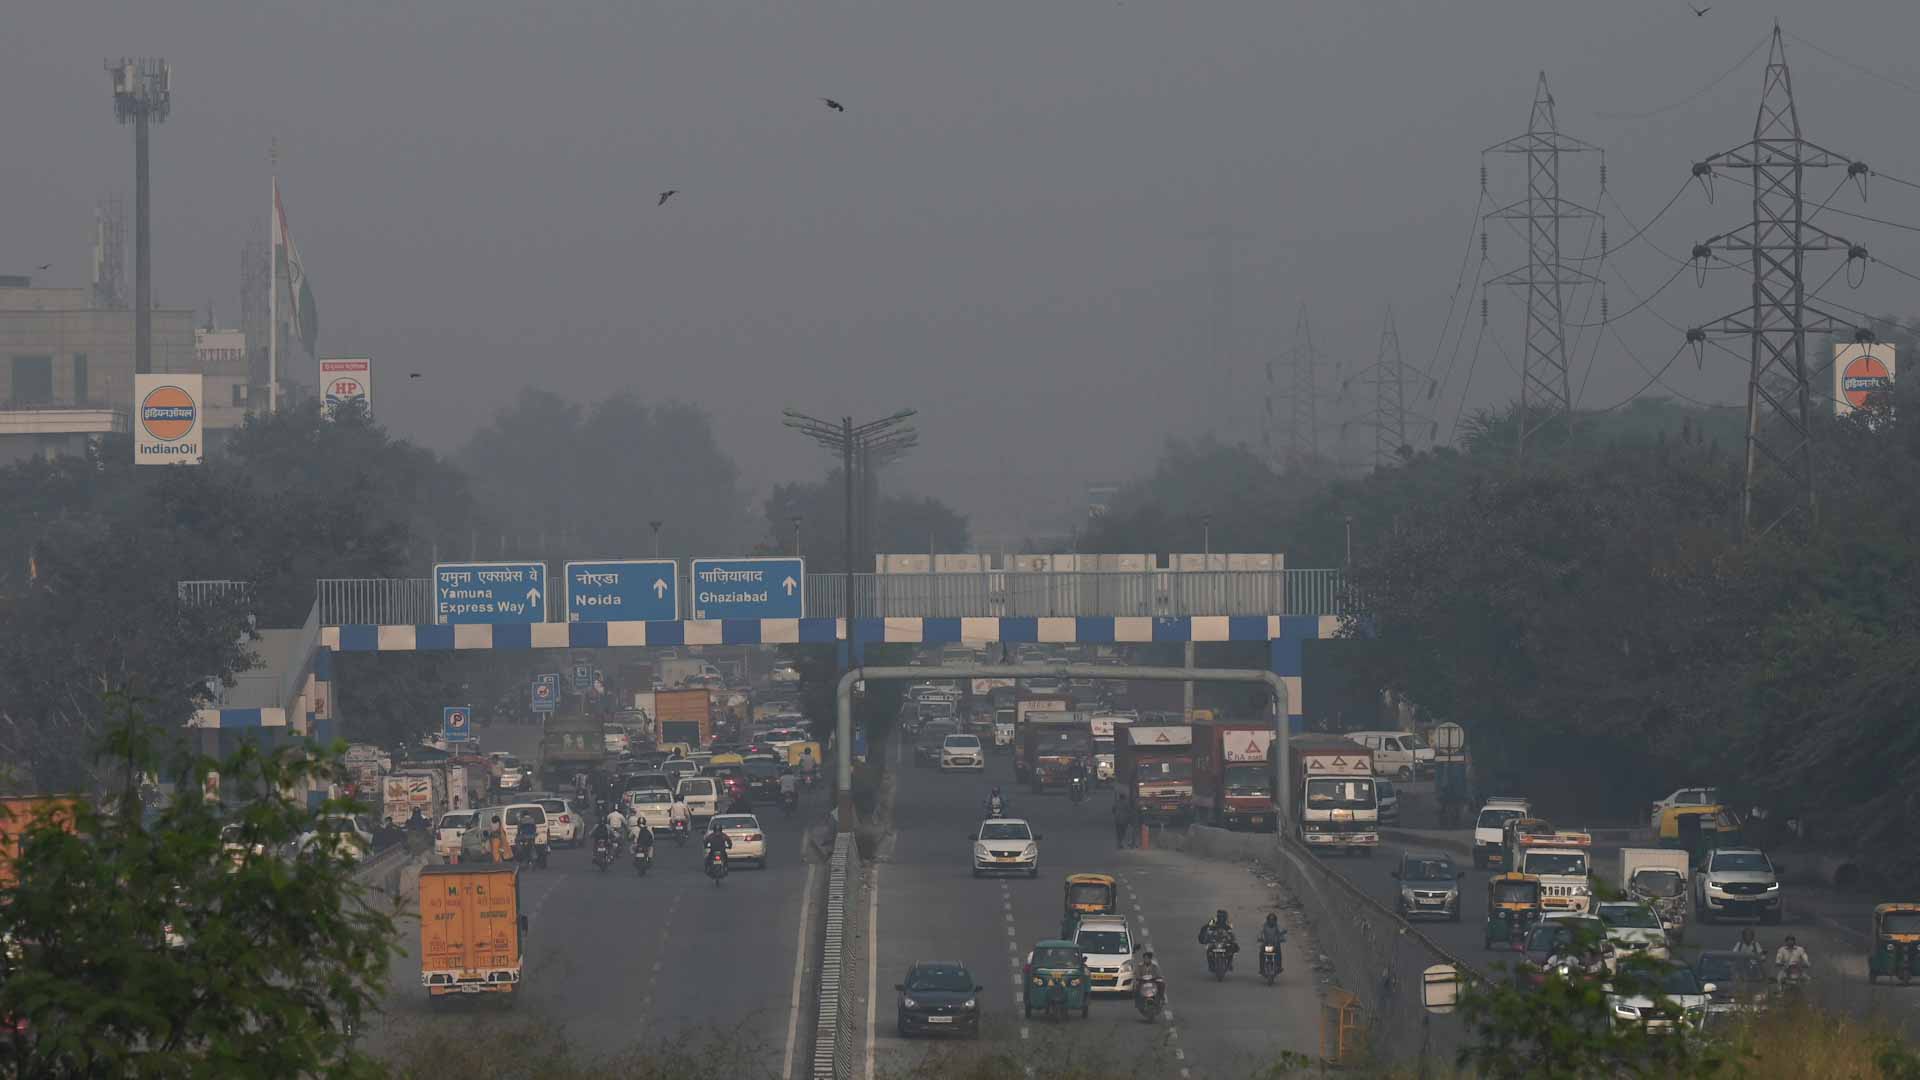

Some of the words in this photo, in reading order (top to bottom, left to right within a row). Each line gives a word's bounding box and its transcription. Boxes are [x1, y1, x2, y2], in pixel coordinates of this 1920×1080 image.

[336, 382, 356, 394] HP
[140, 443, 197, 454] IndianOil
[440, 571, 471, 587] यमुना
[478, 567, 522, 584] एक्सप्रेस
[529, 567, 537, 582] वे
[576, 570, 619, 587] नोएडा
[441, 588, 493, 599] Yamuna
[699, 591, 768, 602] Ghaziabad
[576, 594, 622, 606] Noida
[440, 602, 494, 615] Express
[497, 601, 525, 615] Way
